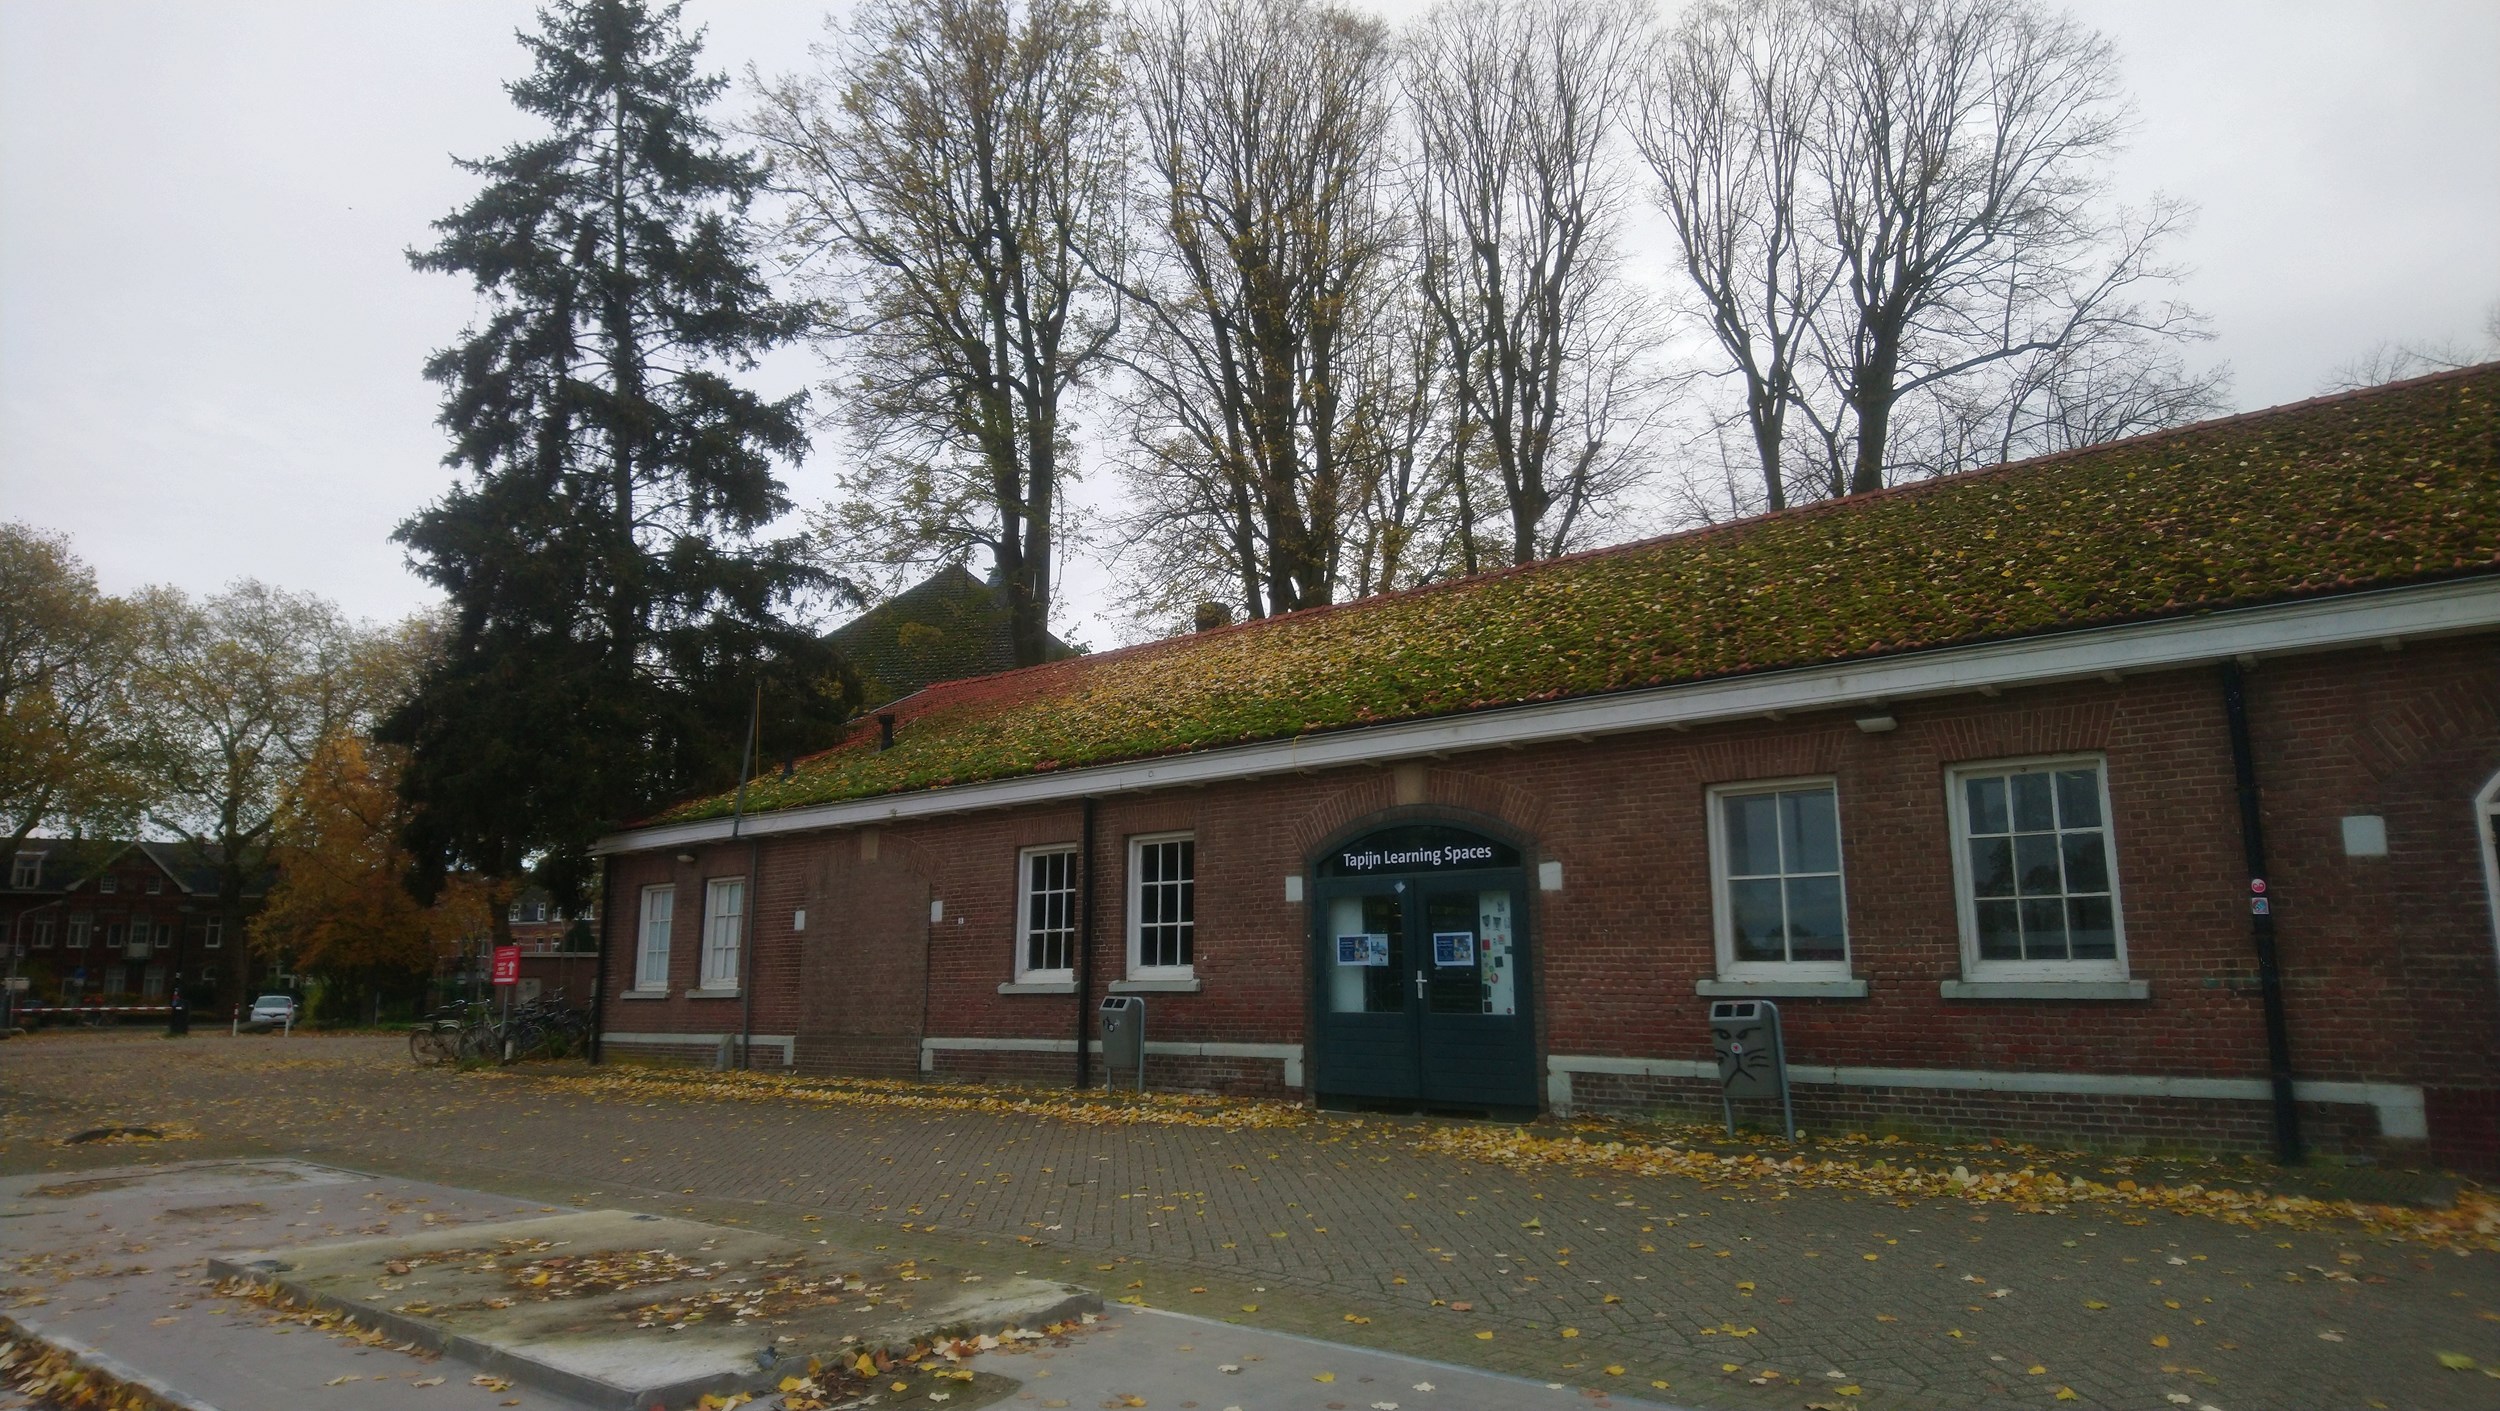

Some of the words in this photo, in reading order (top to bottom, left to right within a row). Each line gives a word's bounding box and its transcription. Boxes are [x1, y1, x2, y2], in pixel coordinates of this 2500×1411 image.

[1343, 851, 1381, 870] Tapijn
[1384, 848, 1442, 866] Learning
[1444, 846, 1492, 864] Spaces
